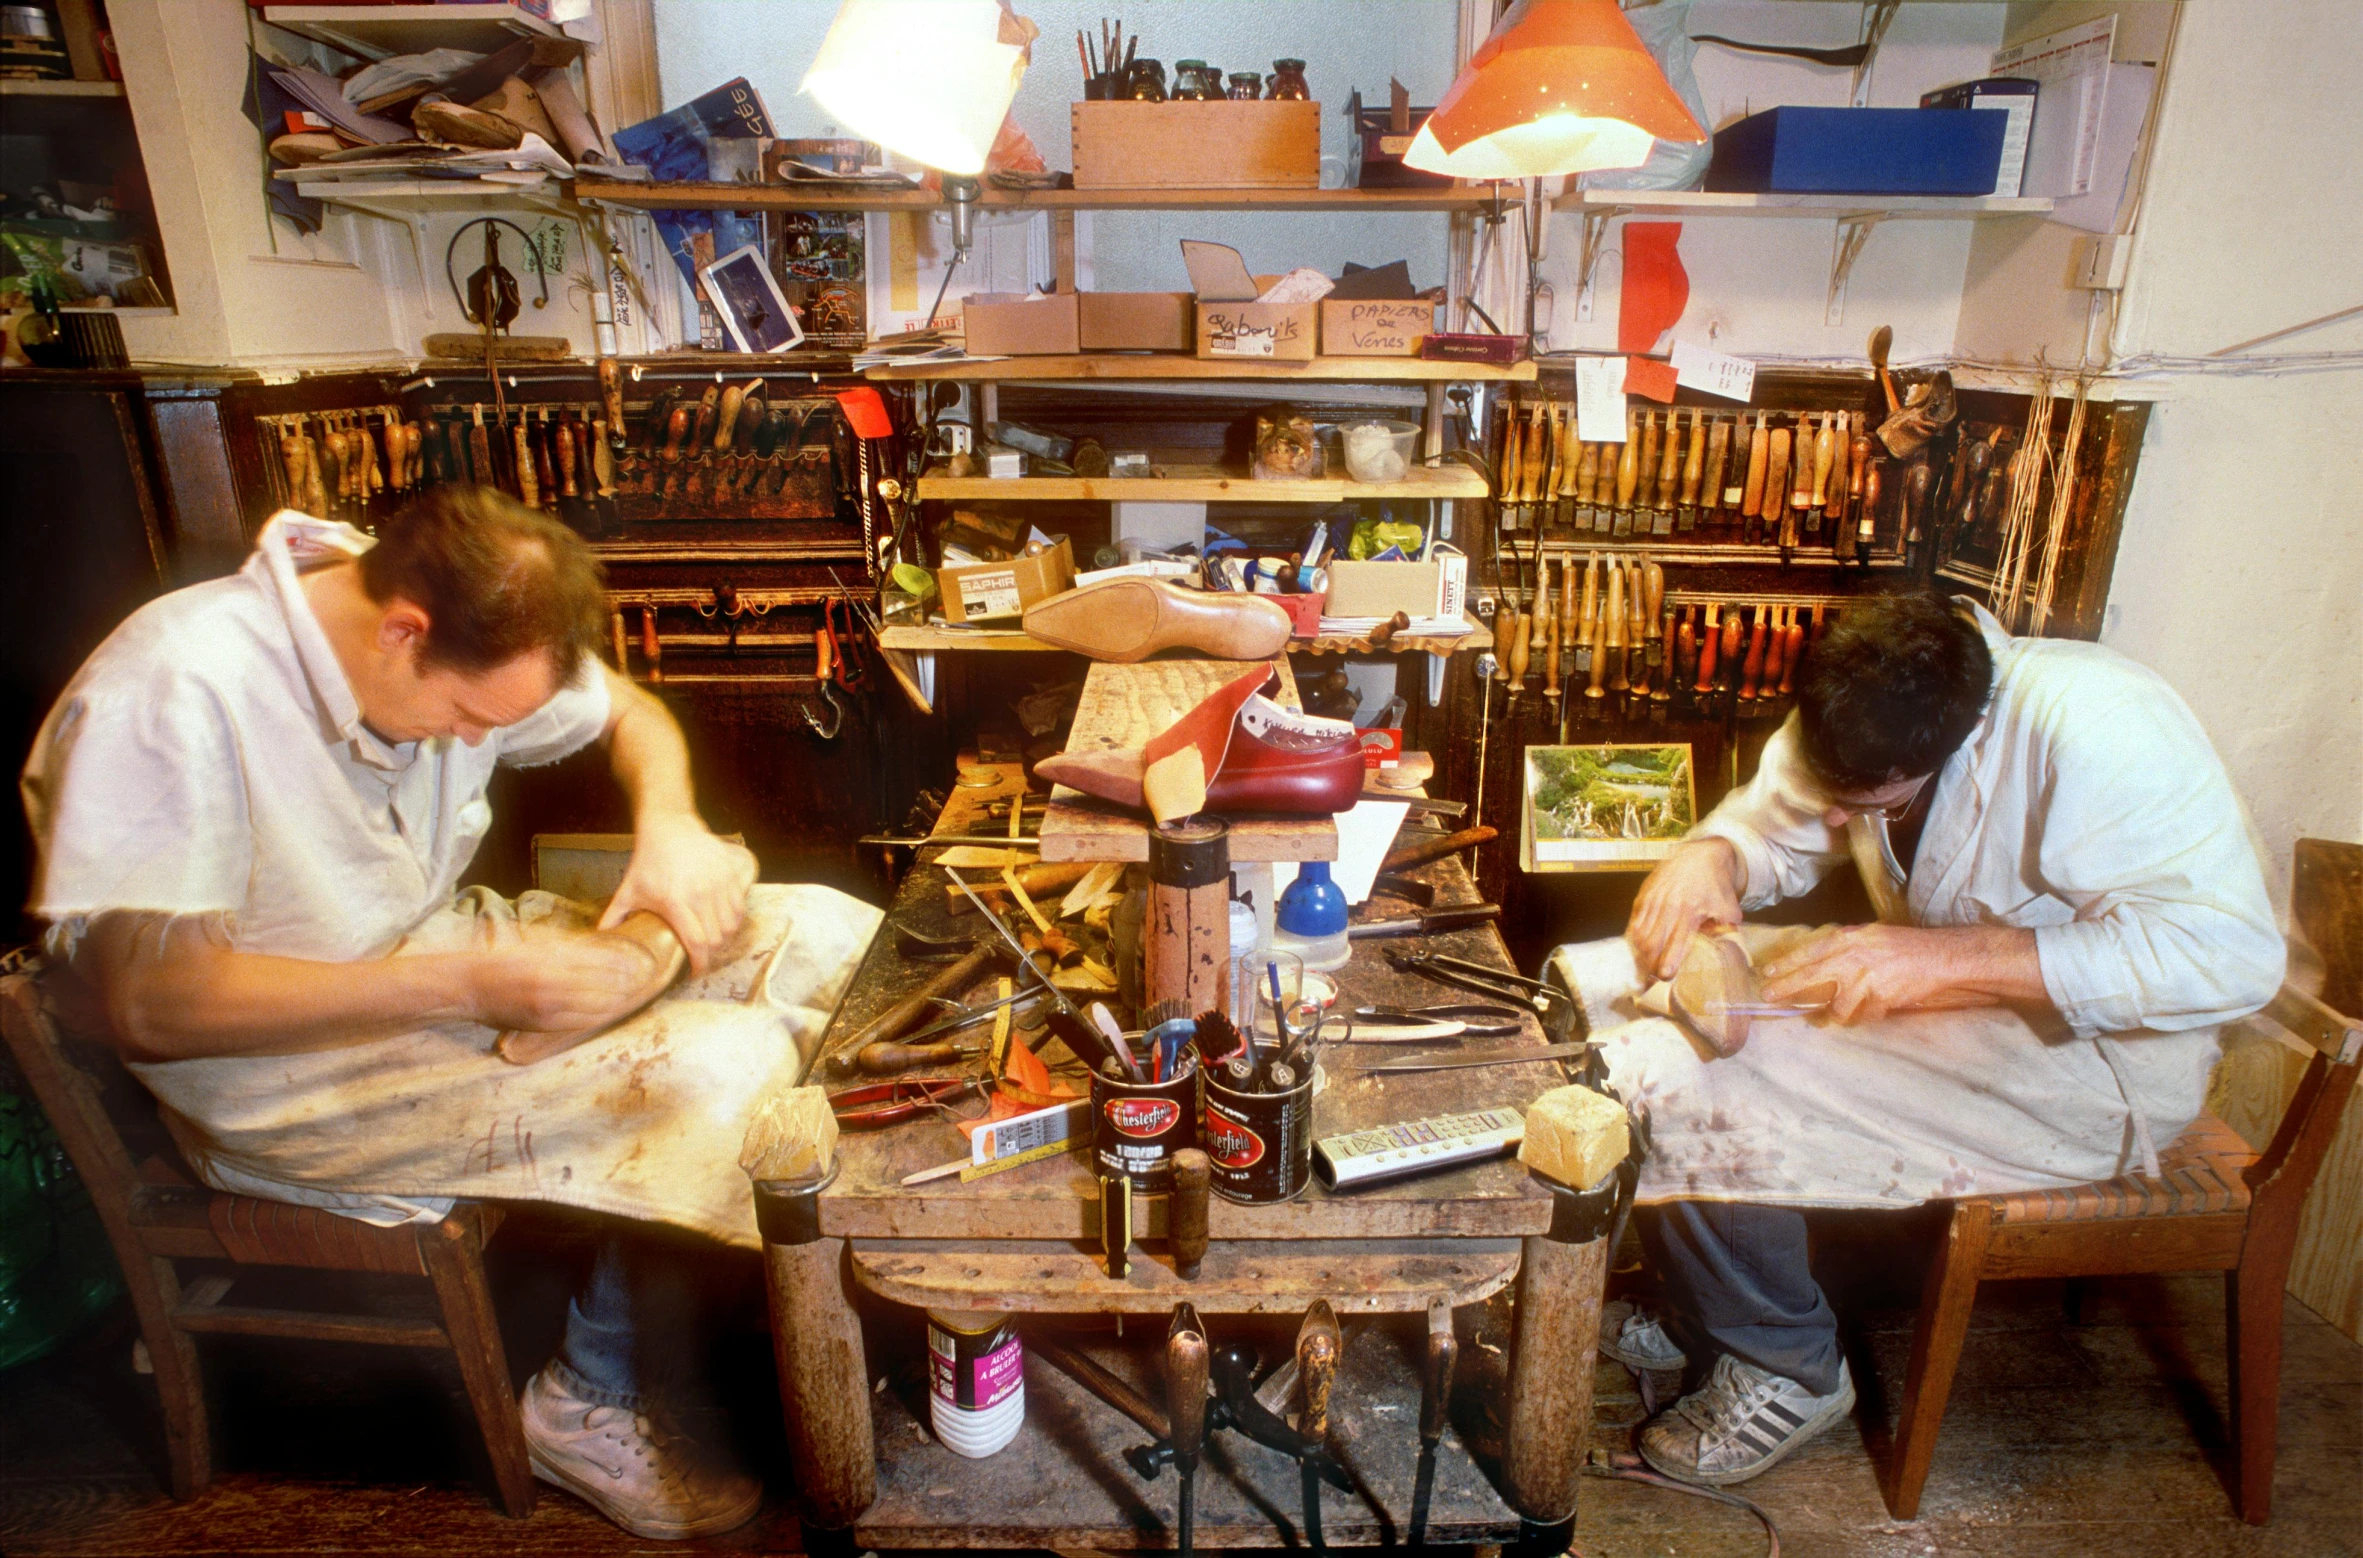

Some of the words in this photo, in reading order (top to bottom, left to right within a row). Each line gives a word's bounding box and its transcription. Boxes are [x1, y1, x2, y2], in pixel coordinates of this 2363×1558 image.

[1351, 304, 1430, 321] PAPIERS
[960, 577, 1015, 592] SAPHIR
[1112, 1104, 1171, 1132] Chesterfield
[990, 1340, 1019, 1366] ALCOOL
